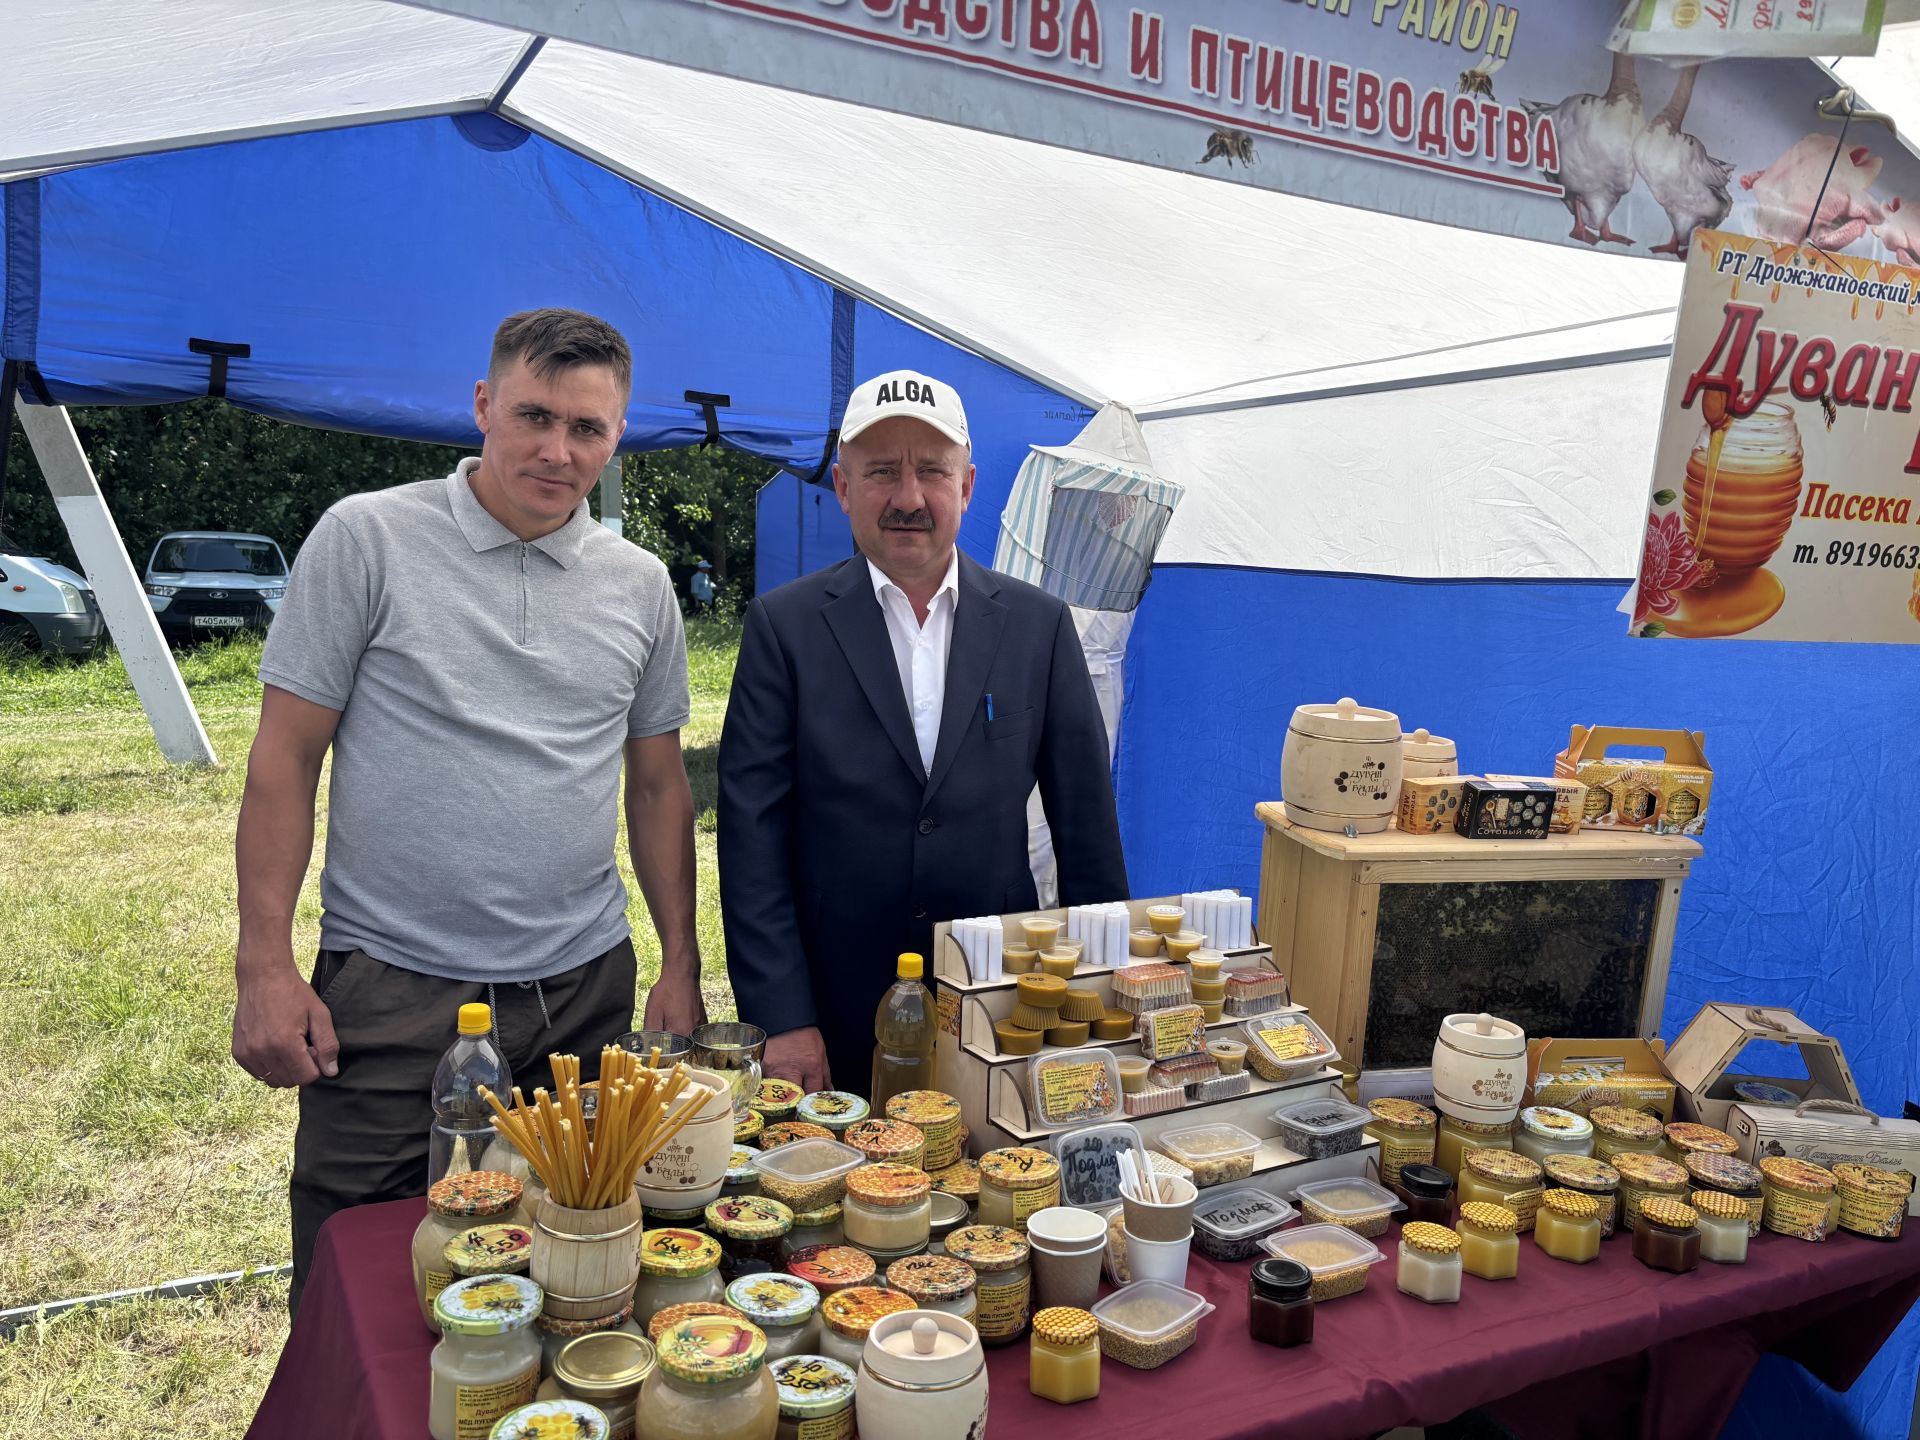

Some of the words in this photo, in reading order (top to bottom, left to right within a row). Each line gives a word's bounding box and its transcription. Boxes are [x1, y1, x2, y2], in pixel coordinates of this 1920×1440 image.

[1129, 11, 1163, 83] И
[1189, 26, 1561, 174] ПТИЦЕВОДСТВА
[1717, 249, 1747, 276] РТ
[1746, 254, 1912, 305] Дрожжановский
[1681, 301, 1920, 419] Дуван
[876, 380, 936, 407] ALGA
[1799, 482, 1910, 525] Пасека
[1826, 540, 1920, 571] 8919663
[1477, 828, 1523, 836] Сотовый
[1592, 1088, 1620, 1103] МЁД
